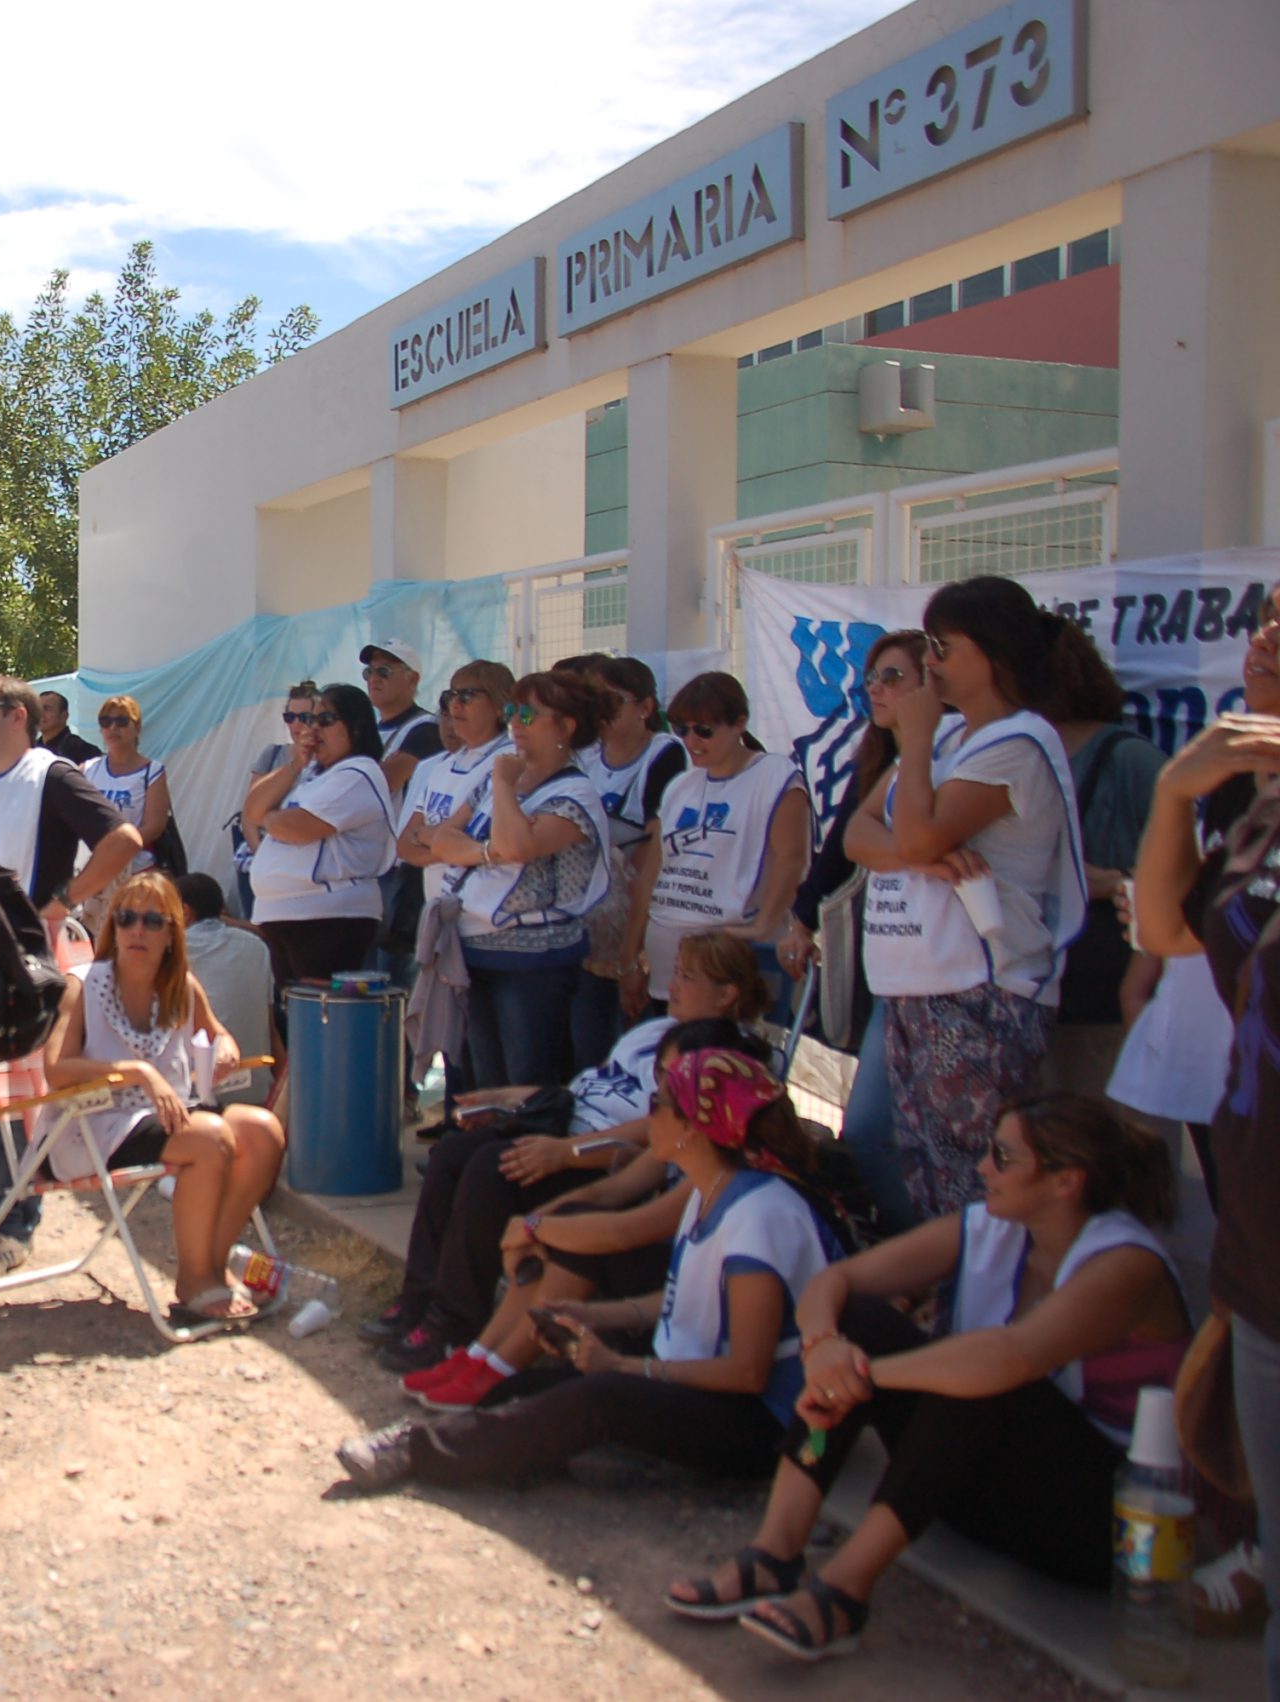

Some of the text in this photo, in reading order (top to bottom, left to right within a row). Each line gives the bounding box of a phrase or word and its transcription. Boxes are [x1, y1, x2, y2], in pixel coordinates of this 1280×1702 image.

[393, 286, 526, 392] ESCUELA
[566, 163, 778, 314] PRIMARIA
[923, 18, 1051, 147] 373
